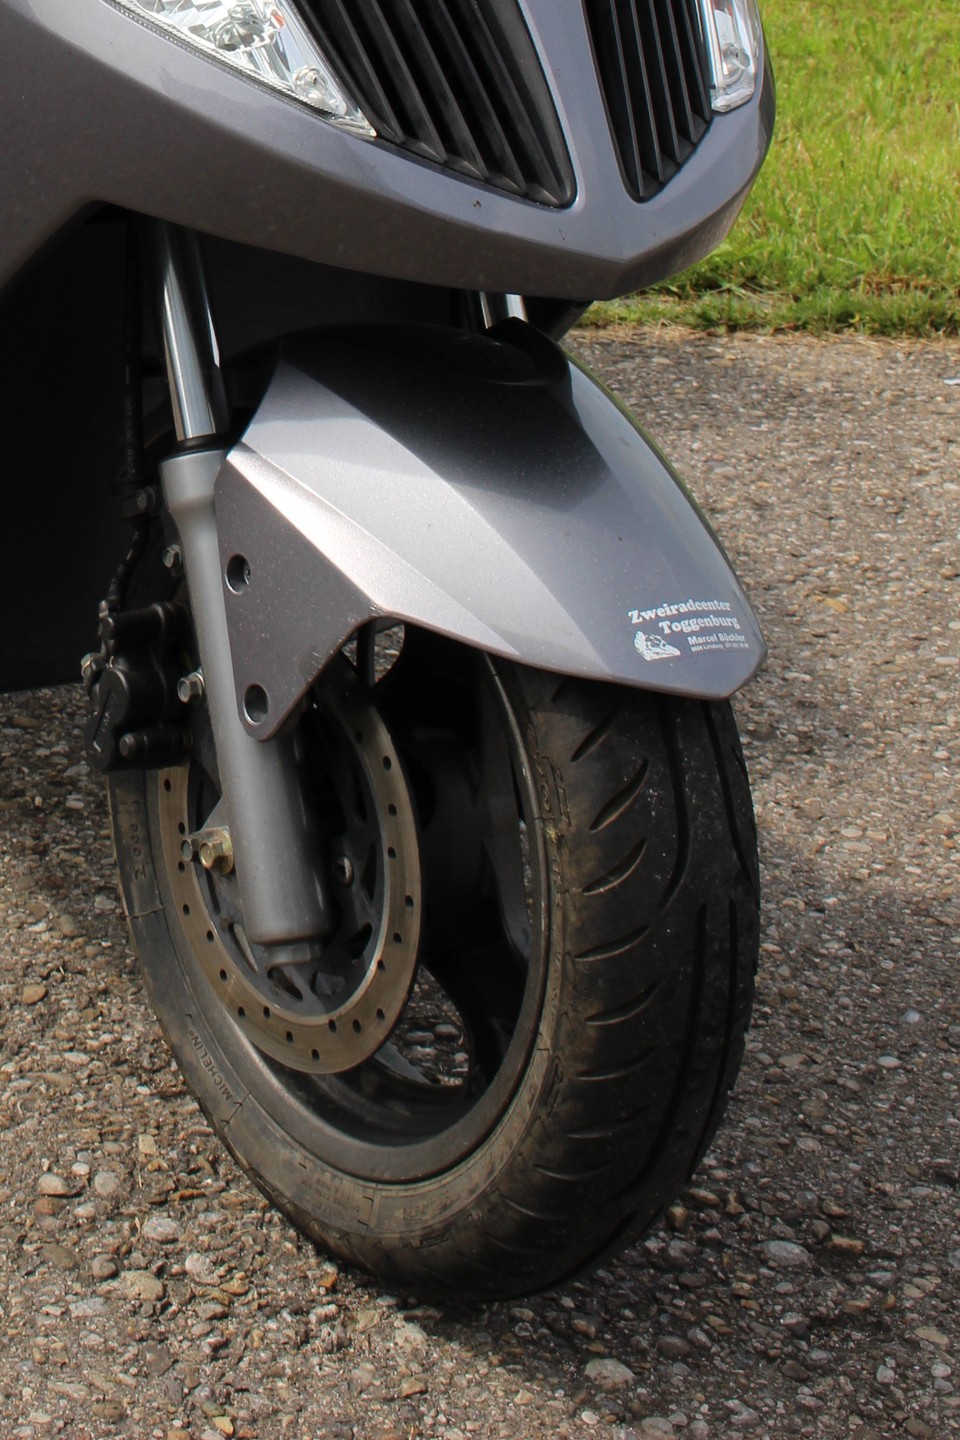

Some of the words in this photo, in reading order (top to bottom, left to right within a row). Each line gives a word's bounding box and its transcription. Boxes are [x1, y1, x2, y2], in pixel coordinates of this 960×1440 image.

[628, 598, 732, 625] Zweiradcenter
[658, 614, 741, 635] Toggenburg
[687, 633, 718, 646] Marcel
[190, 1034, 233, 1101] MICHELIN
